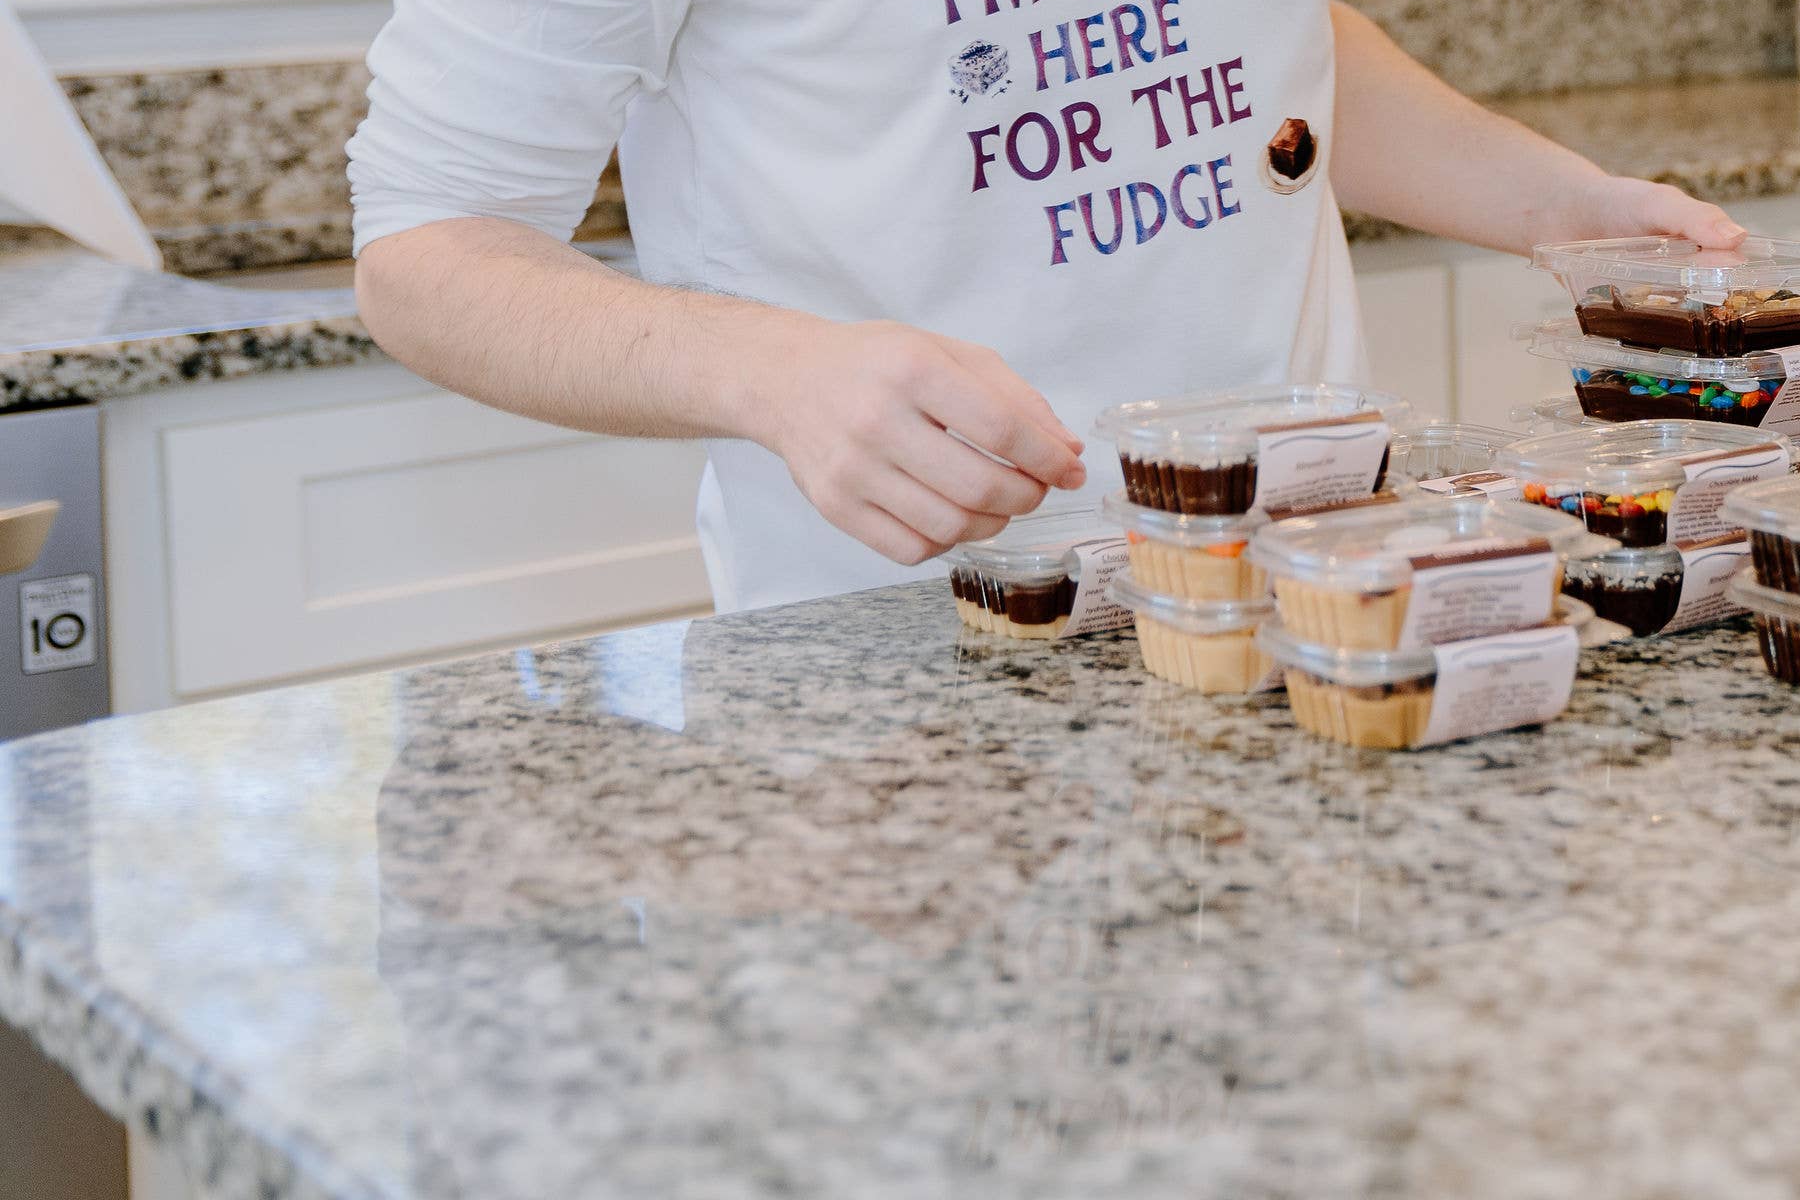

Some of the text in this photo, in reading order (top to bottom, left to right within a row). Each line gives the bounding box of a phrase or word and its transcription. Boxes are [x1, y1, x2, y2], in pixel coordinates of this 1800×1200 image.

[966, 56, 1253, 193] FOR THE
[1042, 153, 1242, 266] FUDGE
